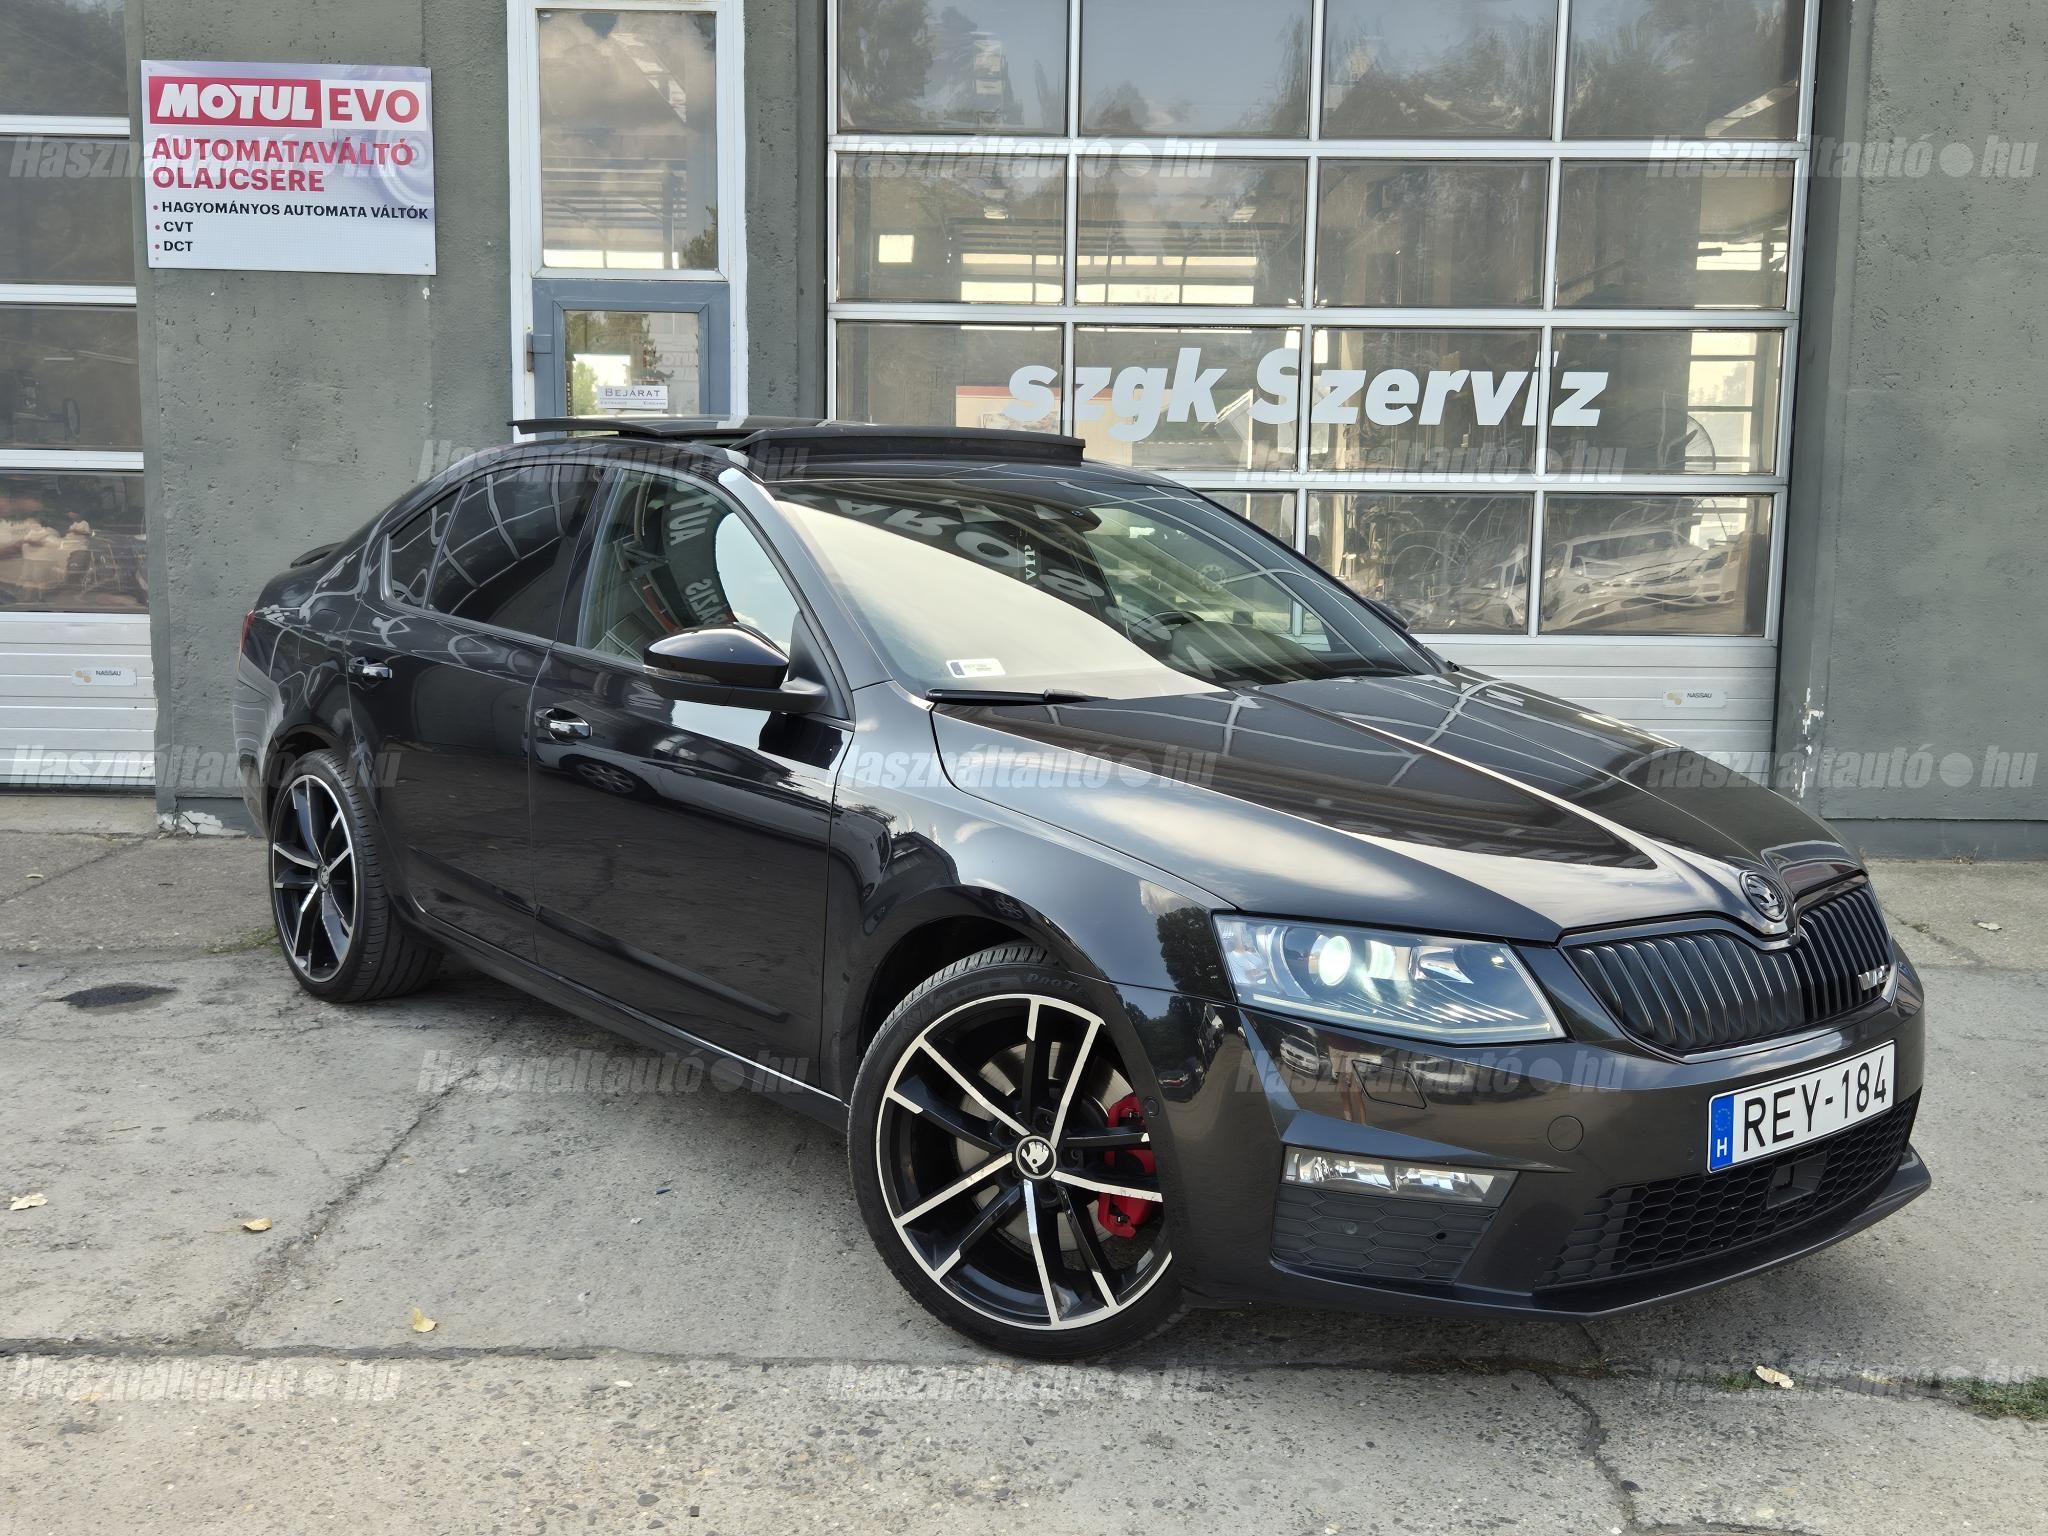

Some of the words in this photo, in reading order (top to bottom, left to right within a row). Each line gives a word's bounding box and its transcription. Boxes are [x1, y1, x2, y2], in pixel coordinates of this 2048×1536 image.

[156, 83, 315, 121] MOTUL
[328, 88, 420, 123] EVO
[152, 137, 414, 166] AUTOMATAVÁLTÓ
[153, 167, 325, 192] OLAJCSERE
[162, 201, 281, 216] HAGYOMÁNYOS
[283, 204, 367, 218] AUTOMATA
[370, 203, 428, 219] VÁLTÓK
[163, 221, 193, 233] CVT
[163, 240, 193, 252] DCT
[1002, 347, 1228, 442] szgk
[1249, 347, 1609, 427] Szerviz
[1743, 1056, 1888, 1153] REY-184
[1716, 1137, 1728, 1158] H
